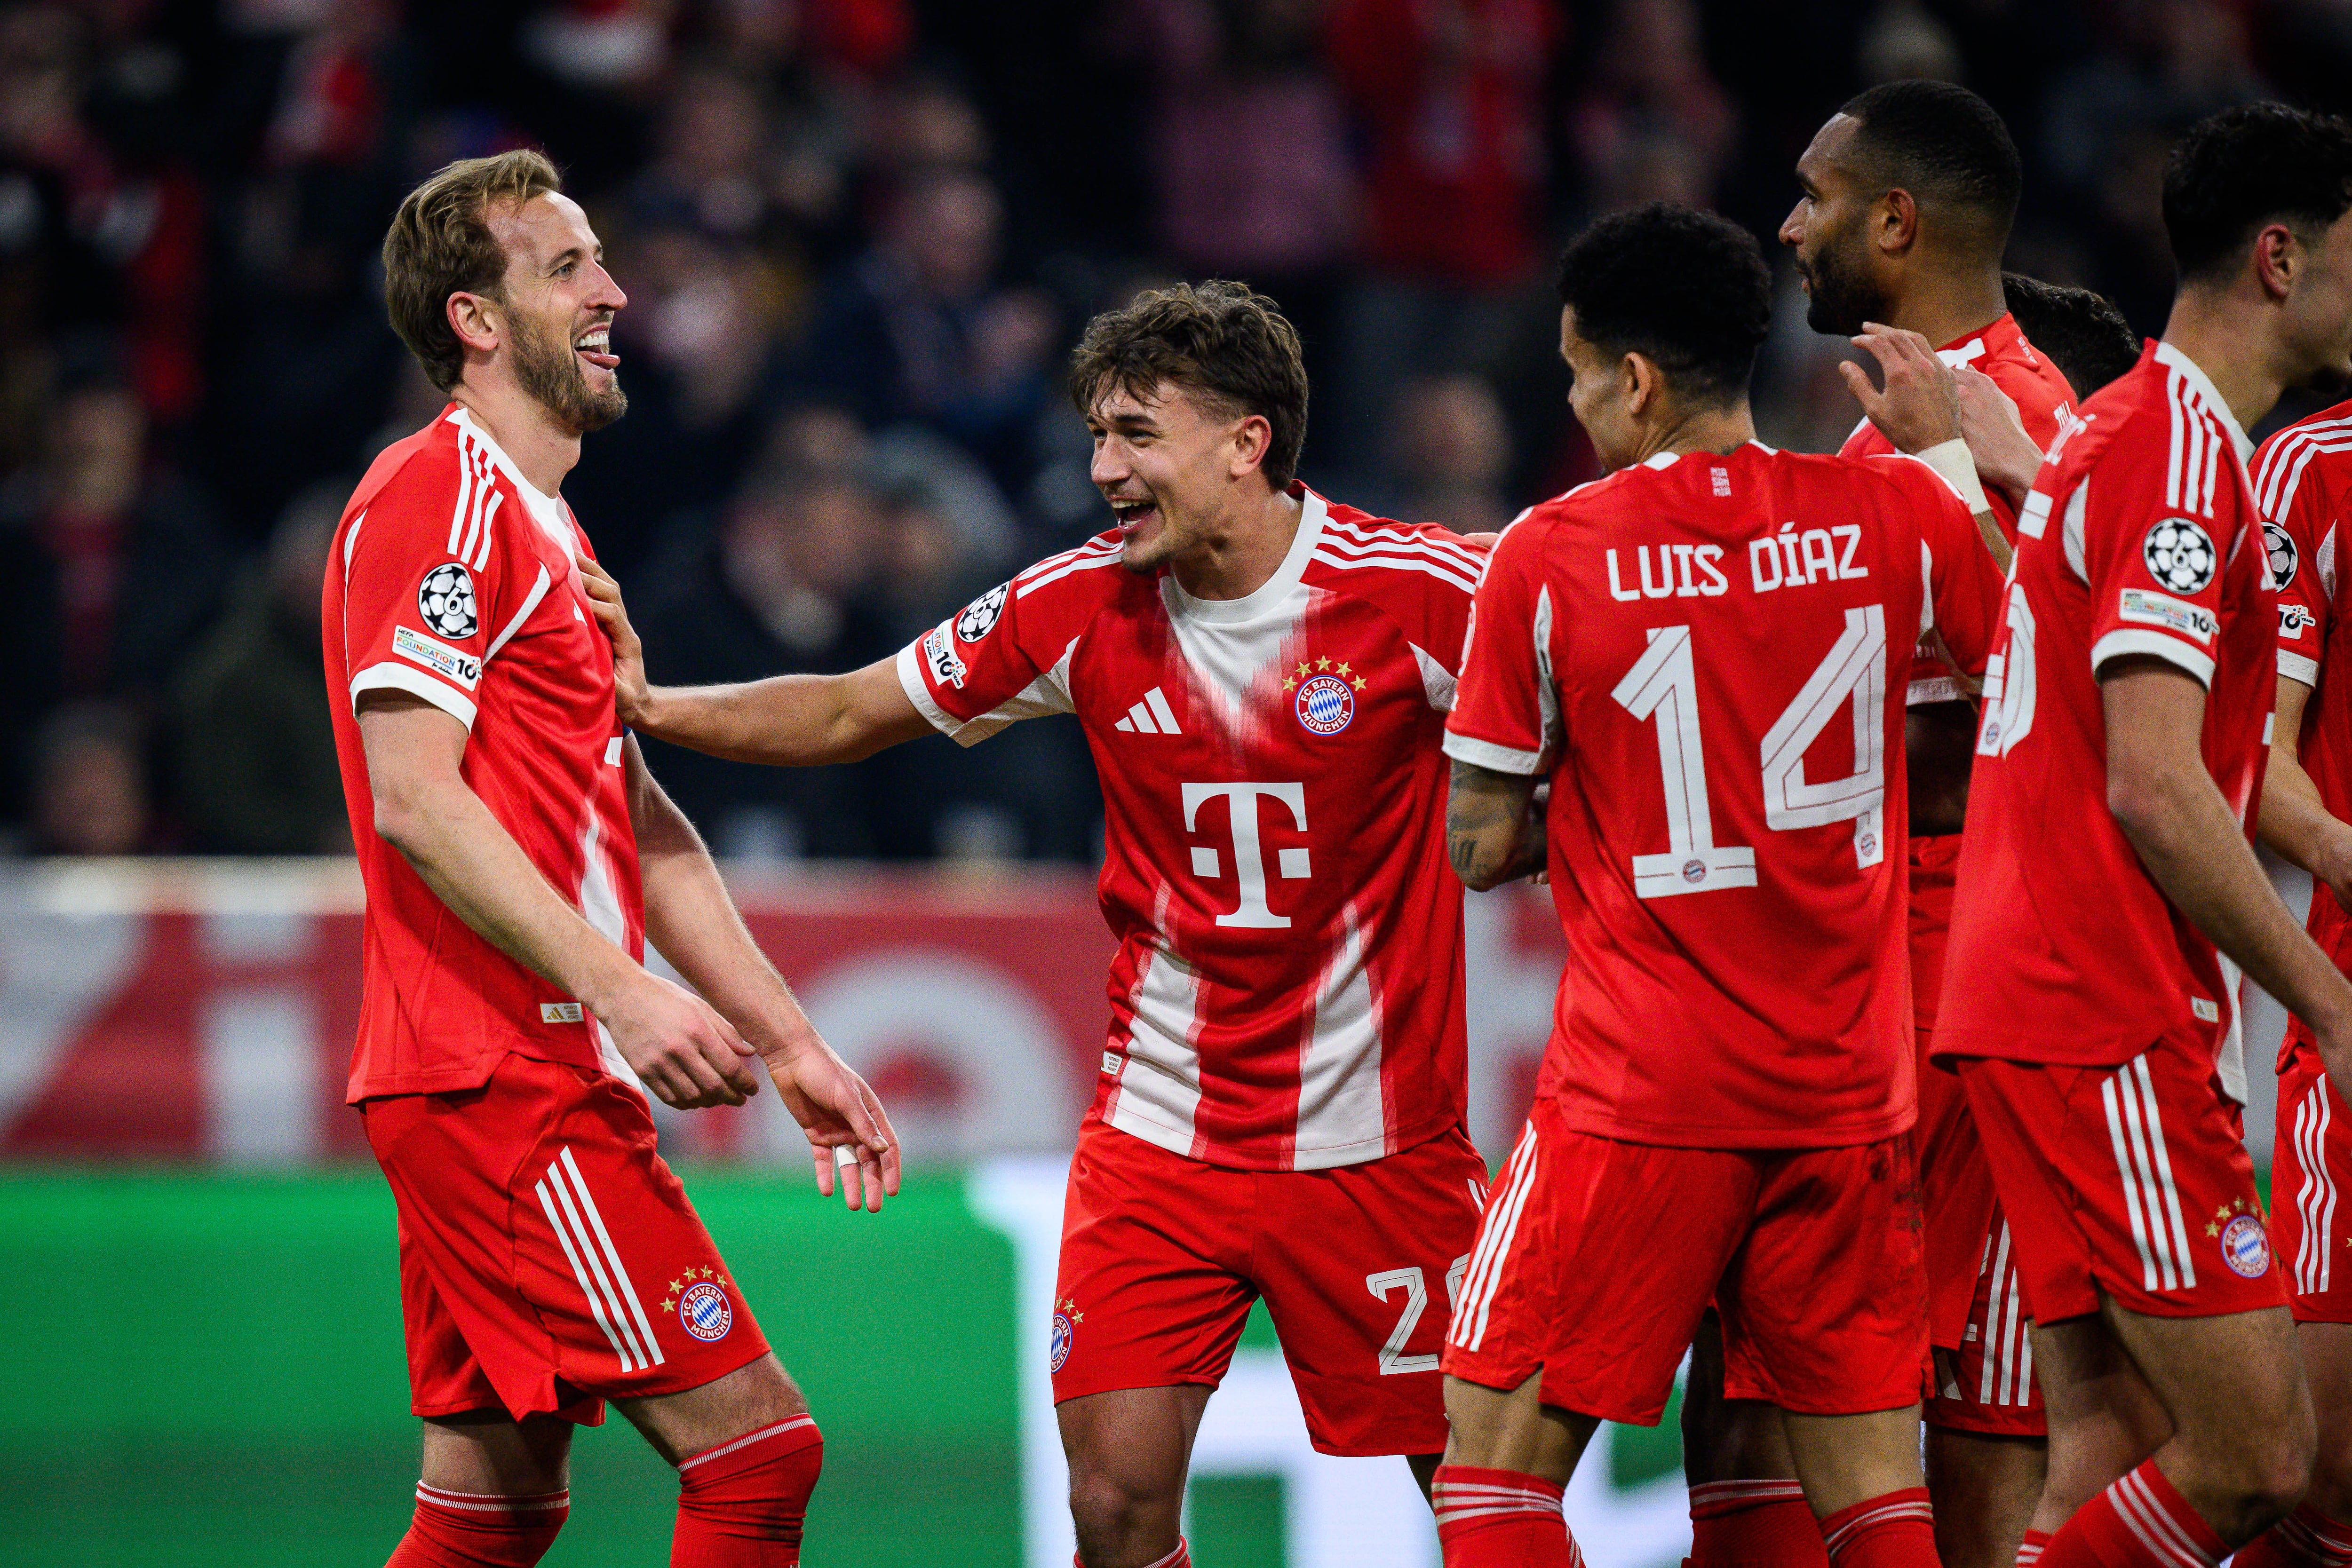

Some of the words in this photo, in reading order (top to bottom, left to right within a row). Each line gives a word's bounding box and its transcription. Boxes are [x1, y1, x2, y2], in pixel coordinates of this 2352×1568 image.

[1606, 543, 1729, 602] LUIS
[1749, 522, 1868, 594] DÍAZ
[2171, 542, 2190, 571] 6
[444, 586, 464, 616] 6
[972, 597, 993, 619] 6
[398, 628, 414, 638] UEFA
[2192, 612, 2210, 633] 10
[397, 636, 456, 668] FOUNDATION
[934, 628, 943, 654] ATION
[457, 658, 477, 680] 10
[936, 651, 954, 676] 10
[953, 673, 961, 686] YEARS
[1300, 688, 1312, 702] FC
[1311, 679, 1350, 702] BAYERN
[1301, 710, 1350, 732] MÜNCHEN
[1611, 604, 1886, 899] 14
[1181, 782, 1311, 928] T
[683, 1302, 692, 1316] FC
[688, 1286, 723, 1302] BAYERN
[690, 1310, 729, 1338] MÜNCHEN
